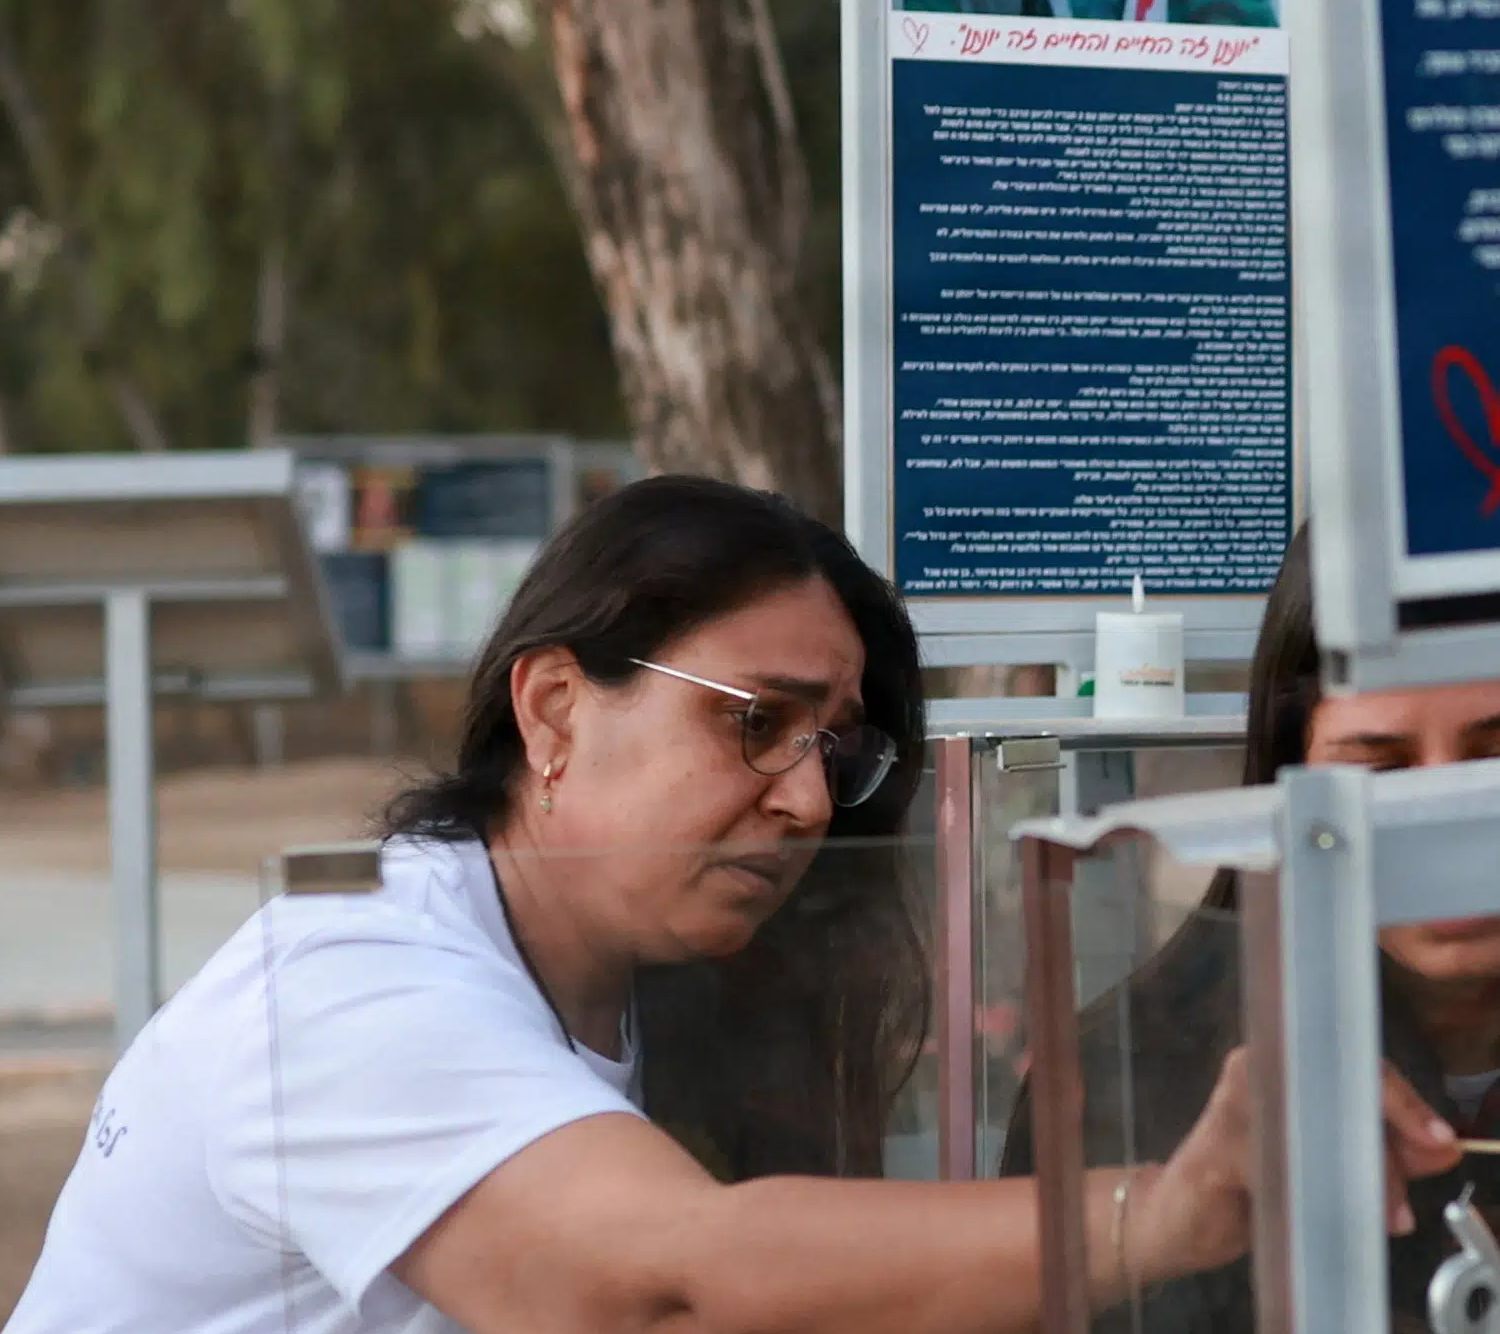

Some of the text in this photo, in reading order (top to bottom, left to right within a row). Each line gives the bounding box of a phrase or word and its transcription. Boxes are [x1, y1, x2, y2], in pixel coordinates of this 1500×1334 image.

[1006, 26, 1036, 51] זה
[1043, 29, 1109, 54] והחיים
[1114, 33, 1173, 55] החיים
[1179, 33, 1208, 57] זה
